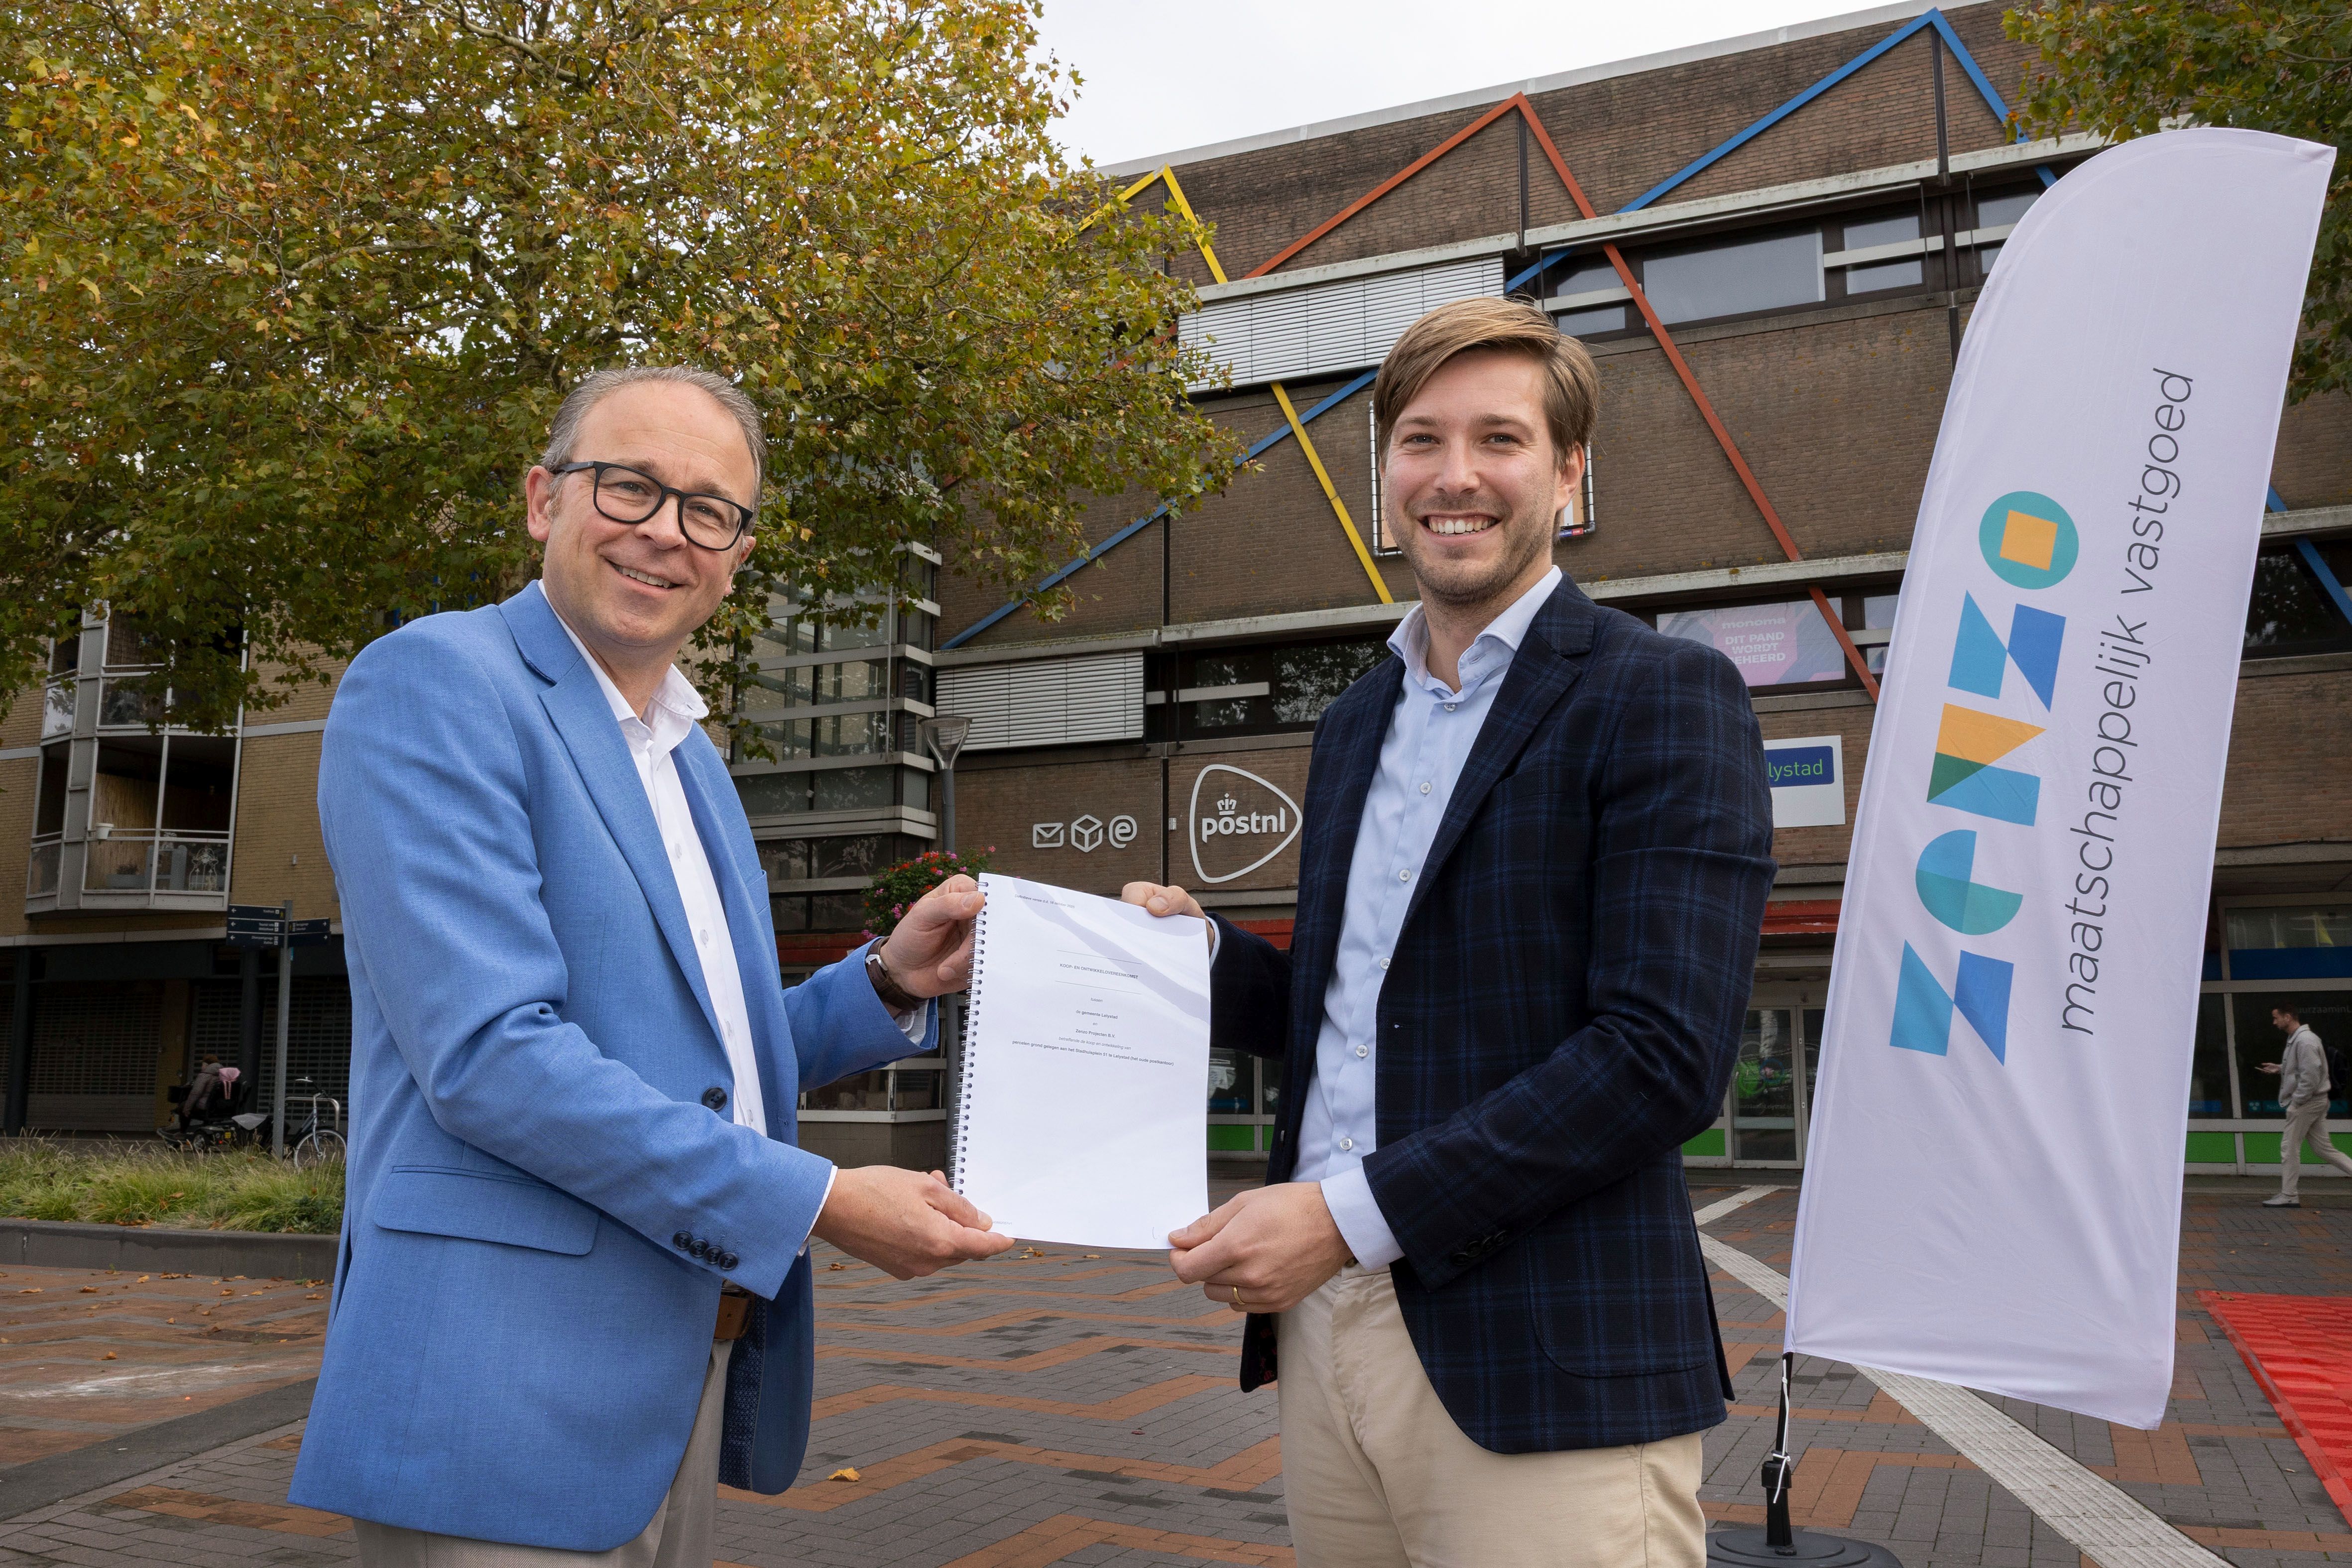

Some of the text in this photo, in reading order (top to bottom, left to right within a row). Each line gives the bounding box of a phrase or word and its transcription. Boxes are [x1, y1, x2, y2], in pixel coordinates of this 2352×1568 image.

[1722, 617, 1786, 629] monoma
[1725, 631, 1785, 645] DIT PAND
[1732, 642, 1779, 654] WORDT
[2062, 368, 2193, 1035] maatschappelijk vastgoed
[1202, 807, 1286, 843] postnl
[1081, 966, 1138, 979] ONTWIKKELOVEREENKOMST
